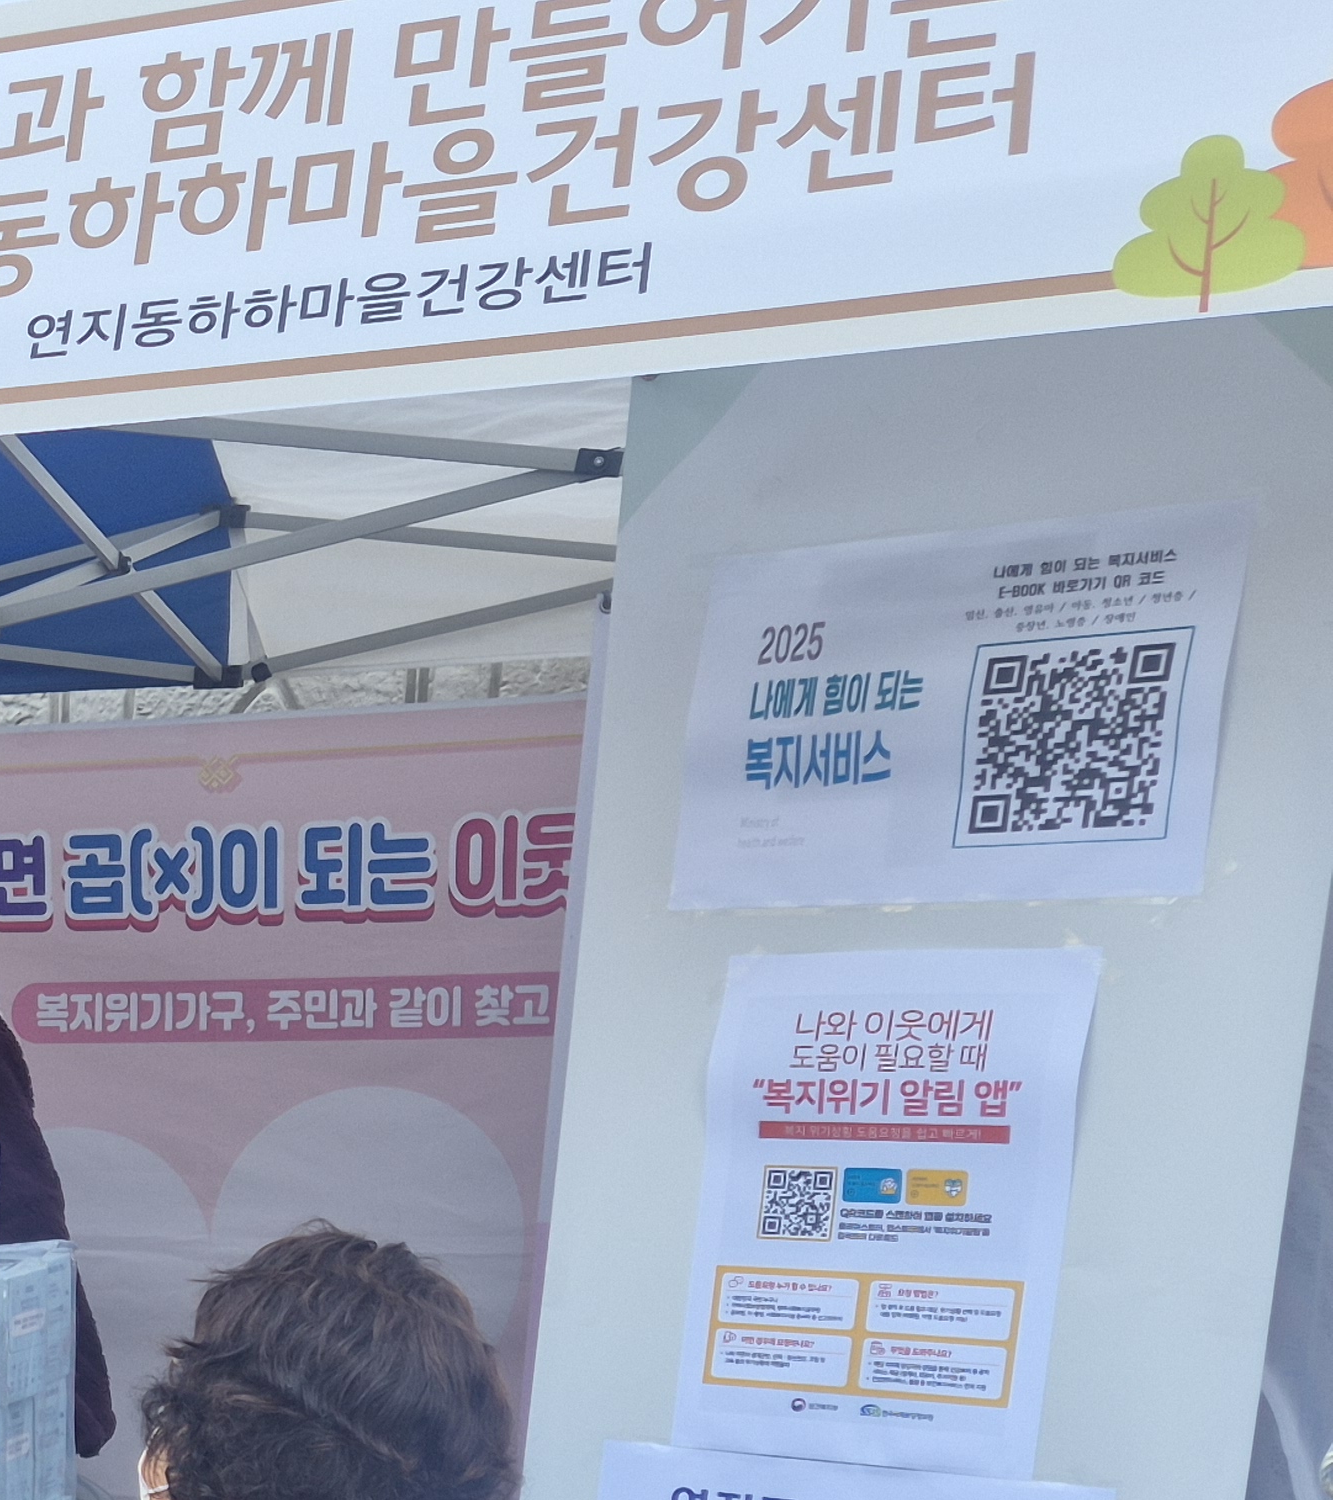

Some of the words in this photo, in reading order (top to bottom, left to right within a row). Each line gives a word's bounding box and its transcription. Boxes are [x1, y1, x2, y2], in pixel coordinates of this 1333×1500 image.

[138, 32, 349, 165] 함께
[25, 242, 652, 358] 연지동하하마을건강센터
[994, 563, 1033, 578] 나에게
[1041, 559, 1066, 576] 힘이
[1074, 557, 1100, 571] 되는
[1108, 549, 1177, 567] 복지서비스
[998, 582, 1046, 599] E-BOOK
[1053, 576, 1107, 595] 바로가기
[1114, 573, 1131, 589] QR
[1138, 570, 1165, 585] 코드
[757, 621, 826, 665] 2025
[750, 673, 815, 721] 나에게
[823, 671, 869, 716] 힘이
[874, 669, 924, 712] 되는
[744, 729, 892, 790] 복지서비스
[300, 820, 431, 908] 되는
[36, 990, 256, 1036] 복지위기가구,
[266, 985, 378, 1031] 주민과
[388, 984, 463, 1030] 같이
[474, 983, 551, 1028] 찾고
[794, 1009, 858, 1043] 나와
[864, 1008, 994, 1043] 이웃에게
[789, 1043, 867, 1071] 도움이
[874, 1043, 956, 1073] 필요할
[959, 1045, 988, 1073] 때
[899, 1079, 966, 1117] 알림
